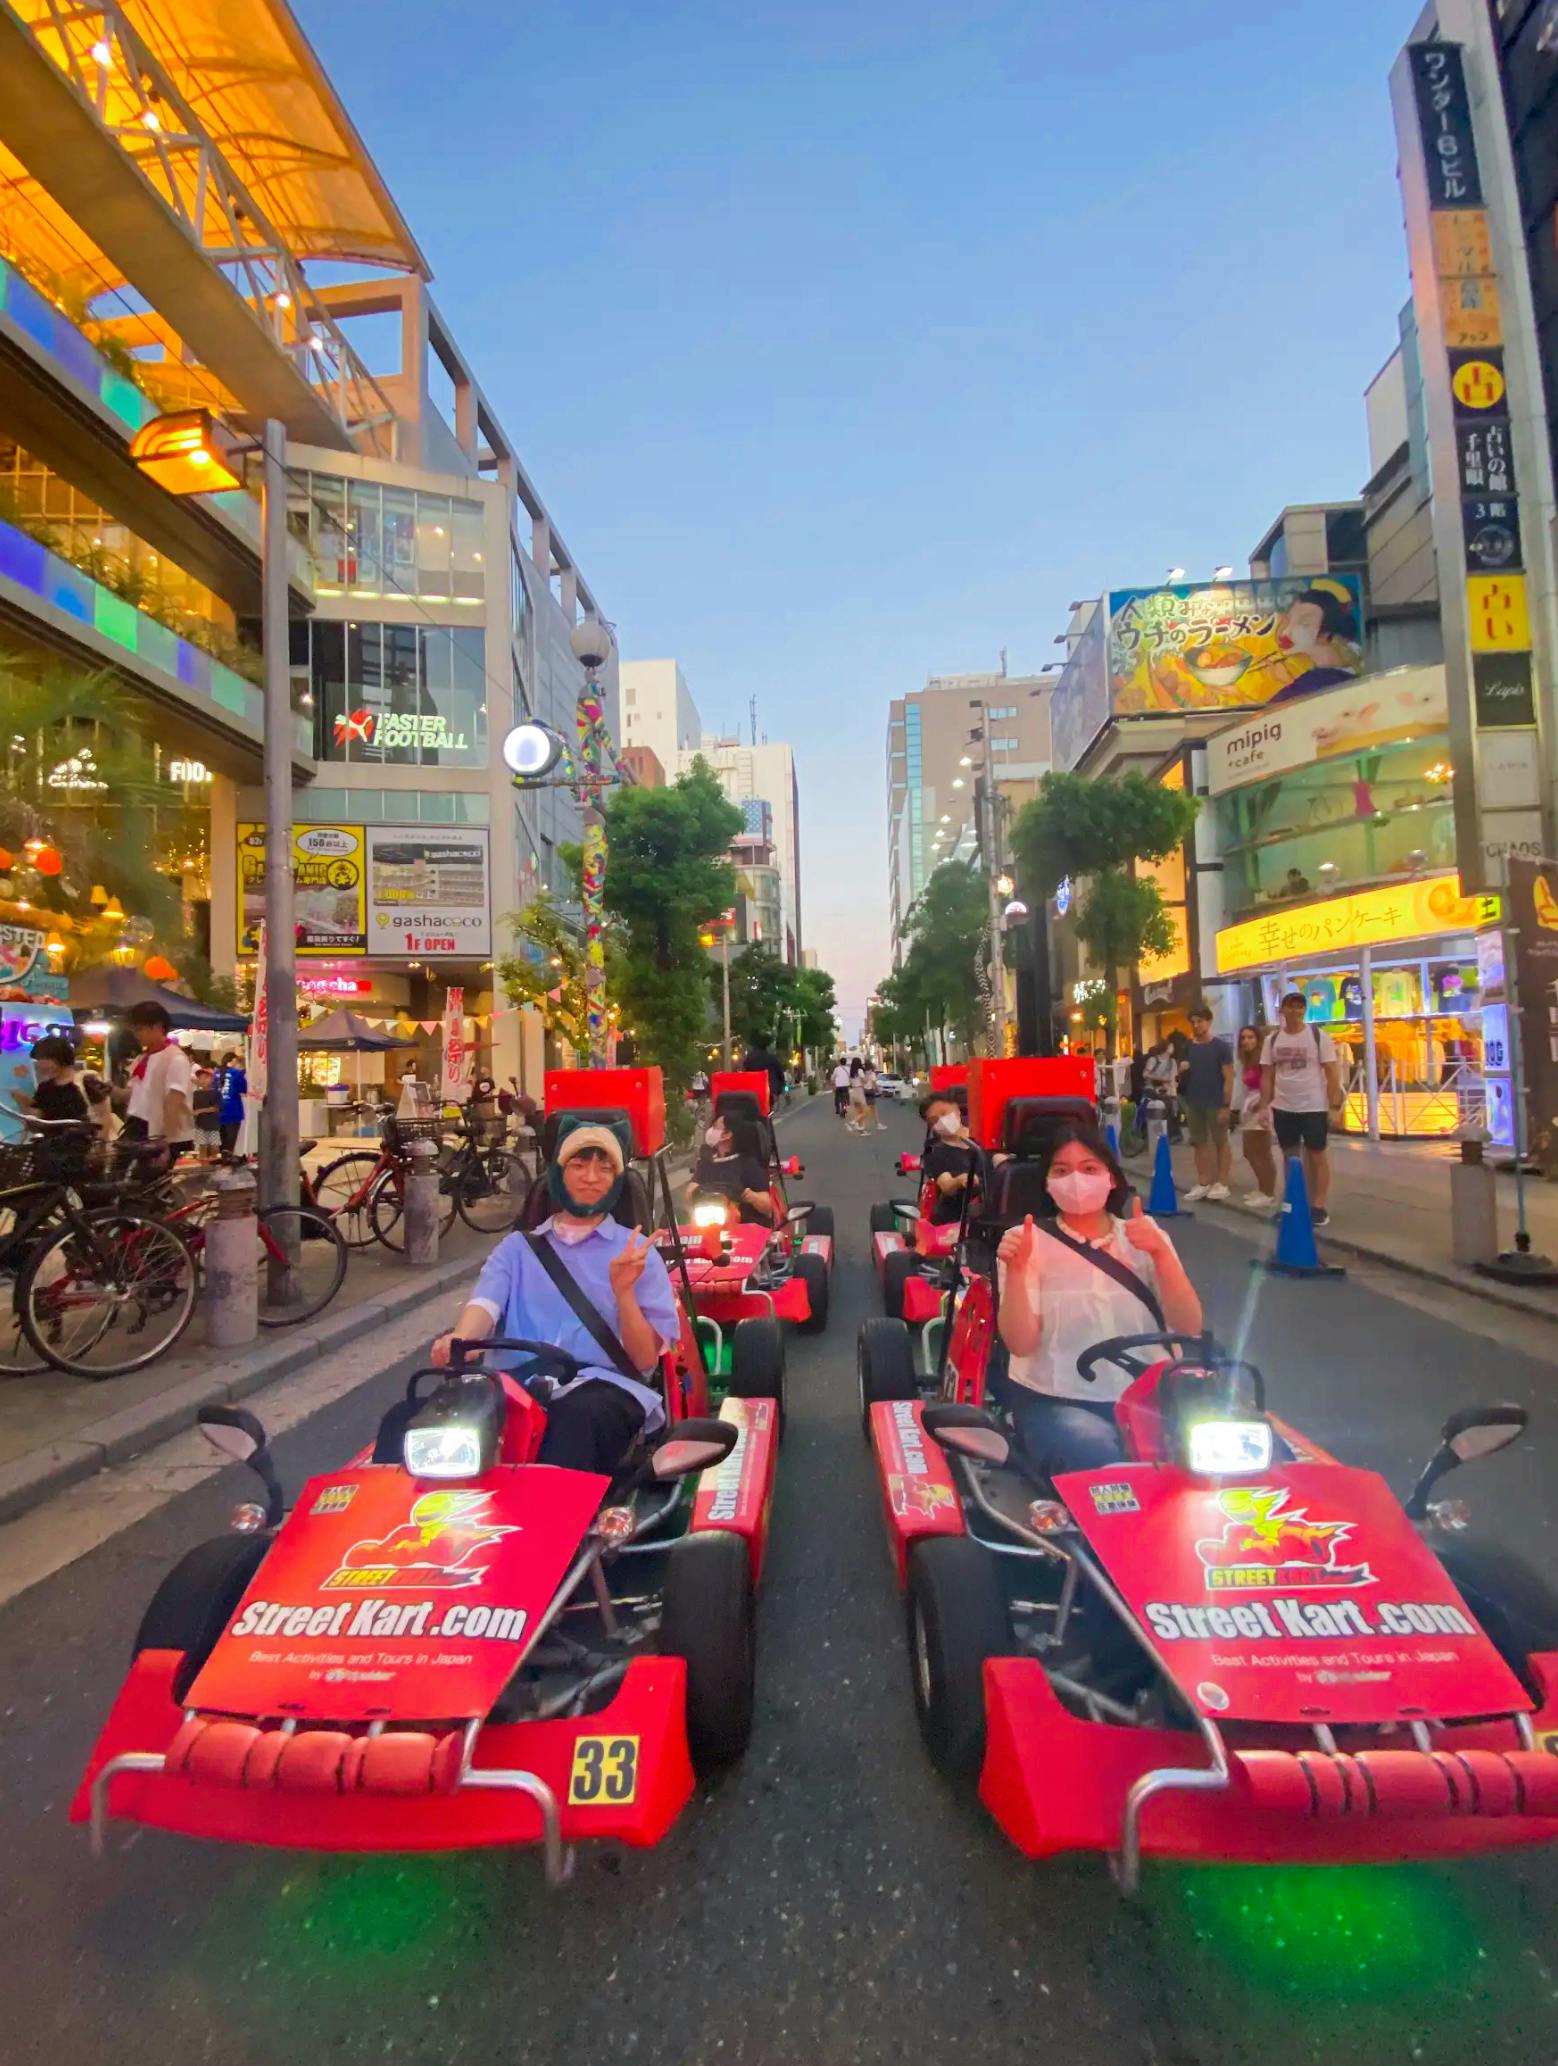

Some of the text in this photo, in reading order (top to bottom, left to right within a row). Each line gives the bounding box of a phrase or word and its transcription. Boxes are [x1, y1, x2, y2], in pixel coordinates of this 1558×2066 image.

[1116, 612, 1278, 650] ウチのラーメン
[376, 713, 447, 732] FASTER
[373, 729, 469, 749] FOOTBALL
[1227, 723, 1281, 755] mipig
[405, 932, 421, 951] 1F
[424, 938, 456, 951] OPEN
[1258, 907, 1401, 957] 幸せのパンケーキ
[249, 1651, 473, 1665] Best Activities and Tours in Japan
[1211, 1650, 1459, 1667] Best Activities and Tours in Japan
[573, 1739, 636, 1799] 33
